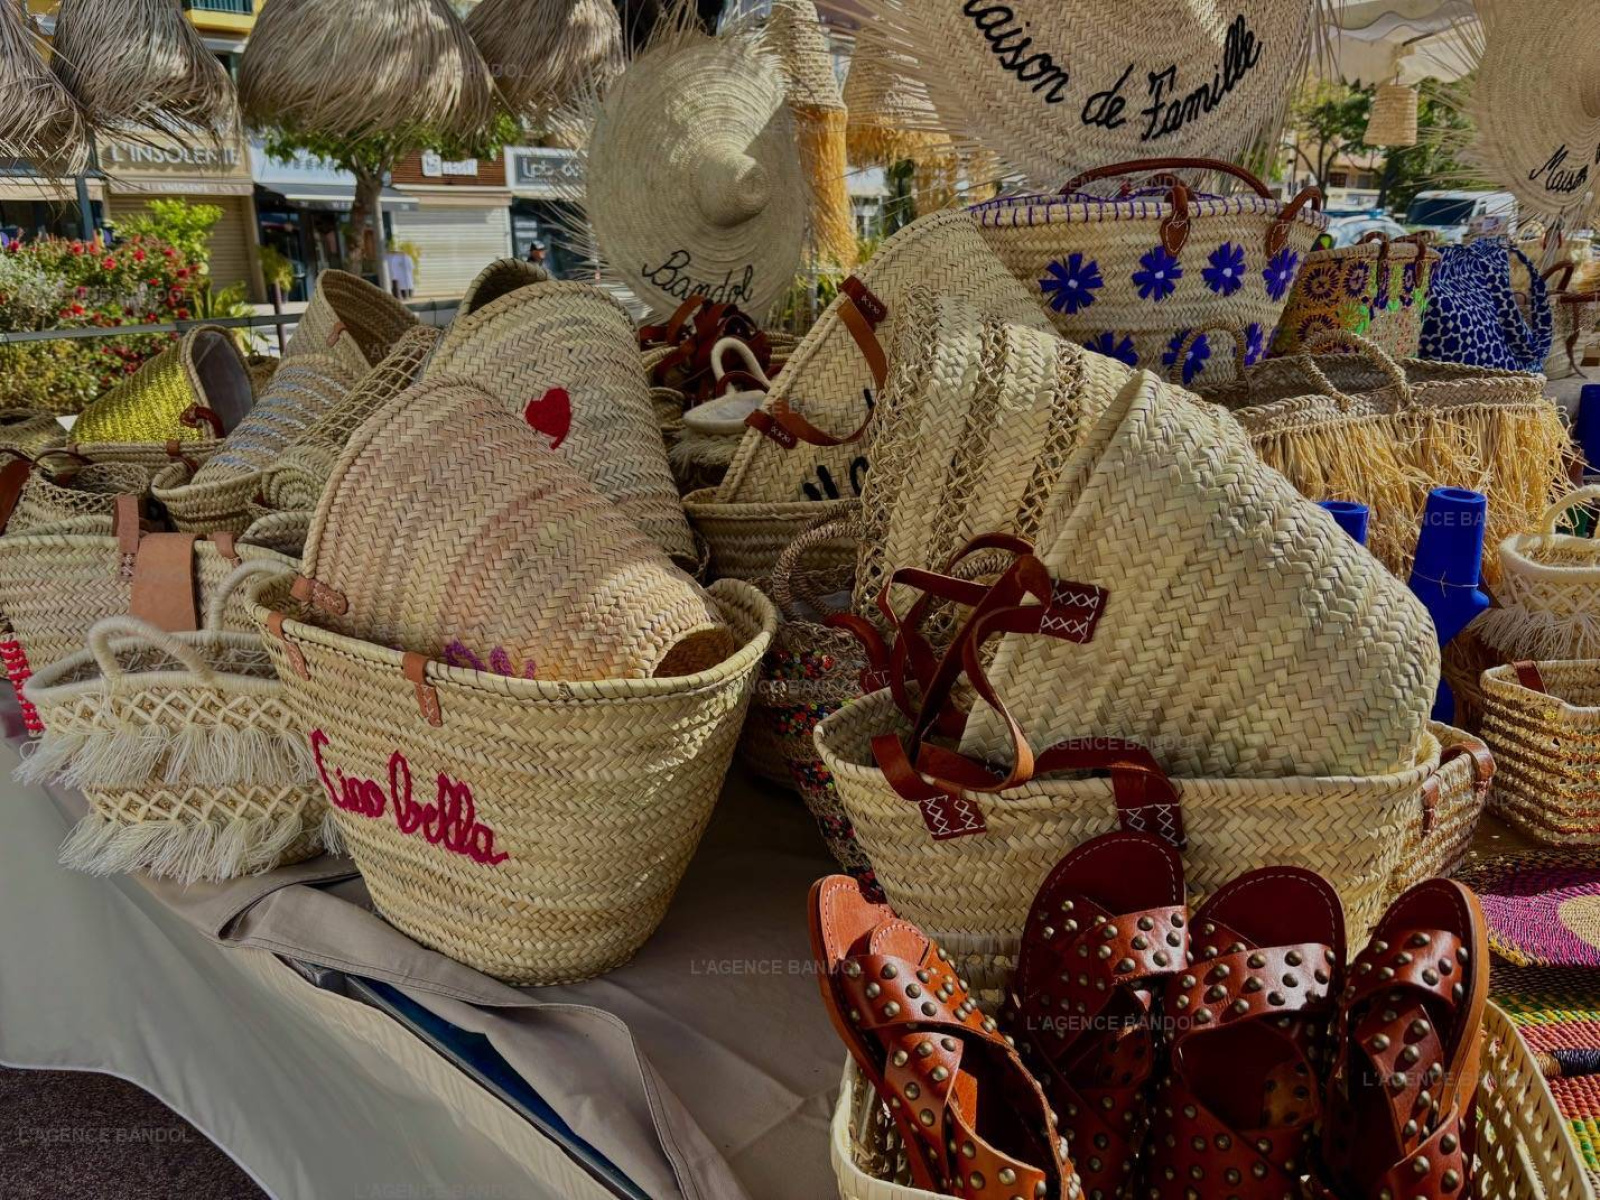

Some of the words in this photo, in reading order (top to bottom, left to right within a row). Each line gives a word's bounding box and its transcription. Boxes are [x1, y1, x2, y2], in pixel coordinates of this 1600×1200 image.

[963, 0, 1069, 103] aison
[1081, 63, 1127, 130] de
[1140, 14, 1263, 141] Famille
[641, 249, 754, 304] Bandol
[310, 728, 387, 818] Ciao
[388, 750, 509, 866] bella
